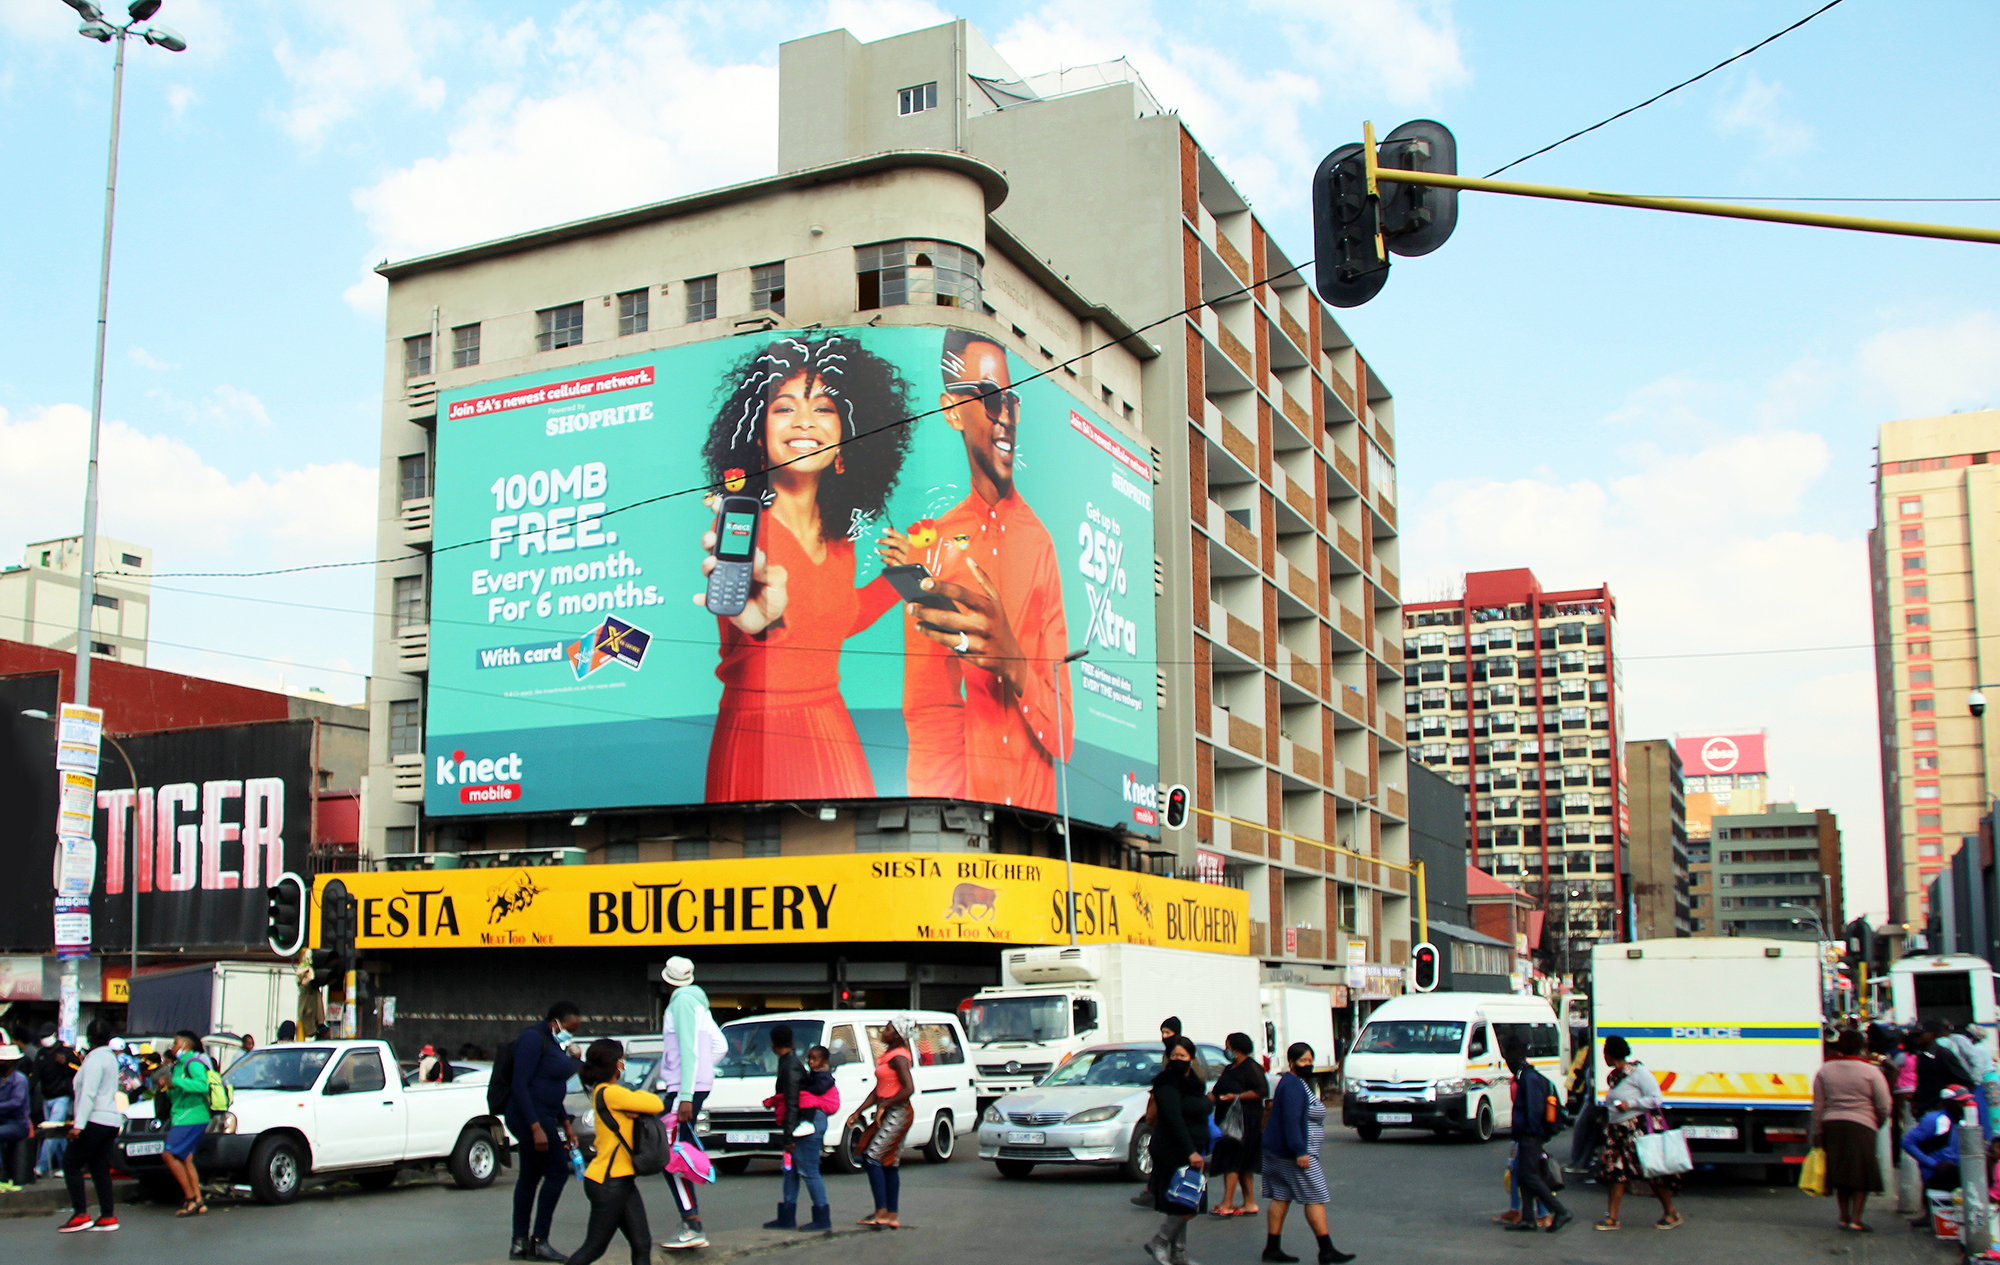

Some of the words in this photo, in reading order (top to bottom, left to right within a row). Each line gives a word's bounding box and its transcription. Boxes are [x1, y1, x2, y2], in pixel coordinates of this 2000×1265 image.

[450, 403, 474, 418] Join
[476, 398, 502, 413] SA's
[503, 389, 545, 409] newest
[547, 382, 595, 400] cellular
[596, 370, 652, 392] network.
[548, 403, 577, 415] Powered
[577, 402, 587, 412] by
[545, 401, 654, 437] SHOPRITE
[490, 461, 608, 512] 100MB
[1112, 471, 1151, 512] SHOPRITE
[490, 502, 618, 560] FREE.
[1086, 501, 1101, 524] Get
[1101, 514, 1111, 534] up
[1111, 517, 1120, 537] to
[471, 567, 545, 595] Every
[550, 550, 643, 586] month.
[1079, 521, 1127, 595] 25%
[488, 596, 530, 623] For
[536, 592, 552, 617] 6
[558, 580, 664, 615] months.
[1084, 582, 1137, 656] Xtra
[481, 647, 521, 668] With
[524, 642, 563, 663] card
[1708, 747, 1735, 760] absa
[469, 785, 513, 802] mobile
[96, 777, 285, 895] TIGER
[871, 856, 941, 879] SIESTA
[958, 857, 1043, 882] BUTCHERY
[355, 885, 460, 938] ESTA
[589, 878, 837, 934] BUTCHERY
[1167, 896, 1239, 945] BUTCHERY
[1672, 1027, 1741, 1039] POLICE
